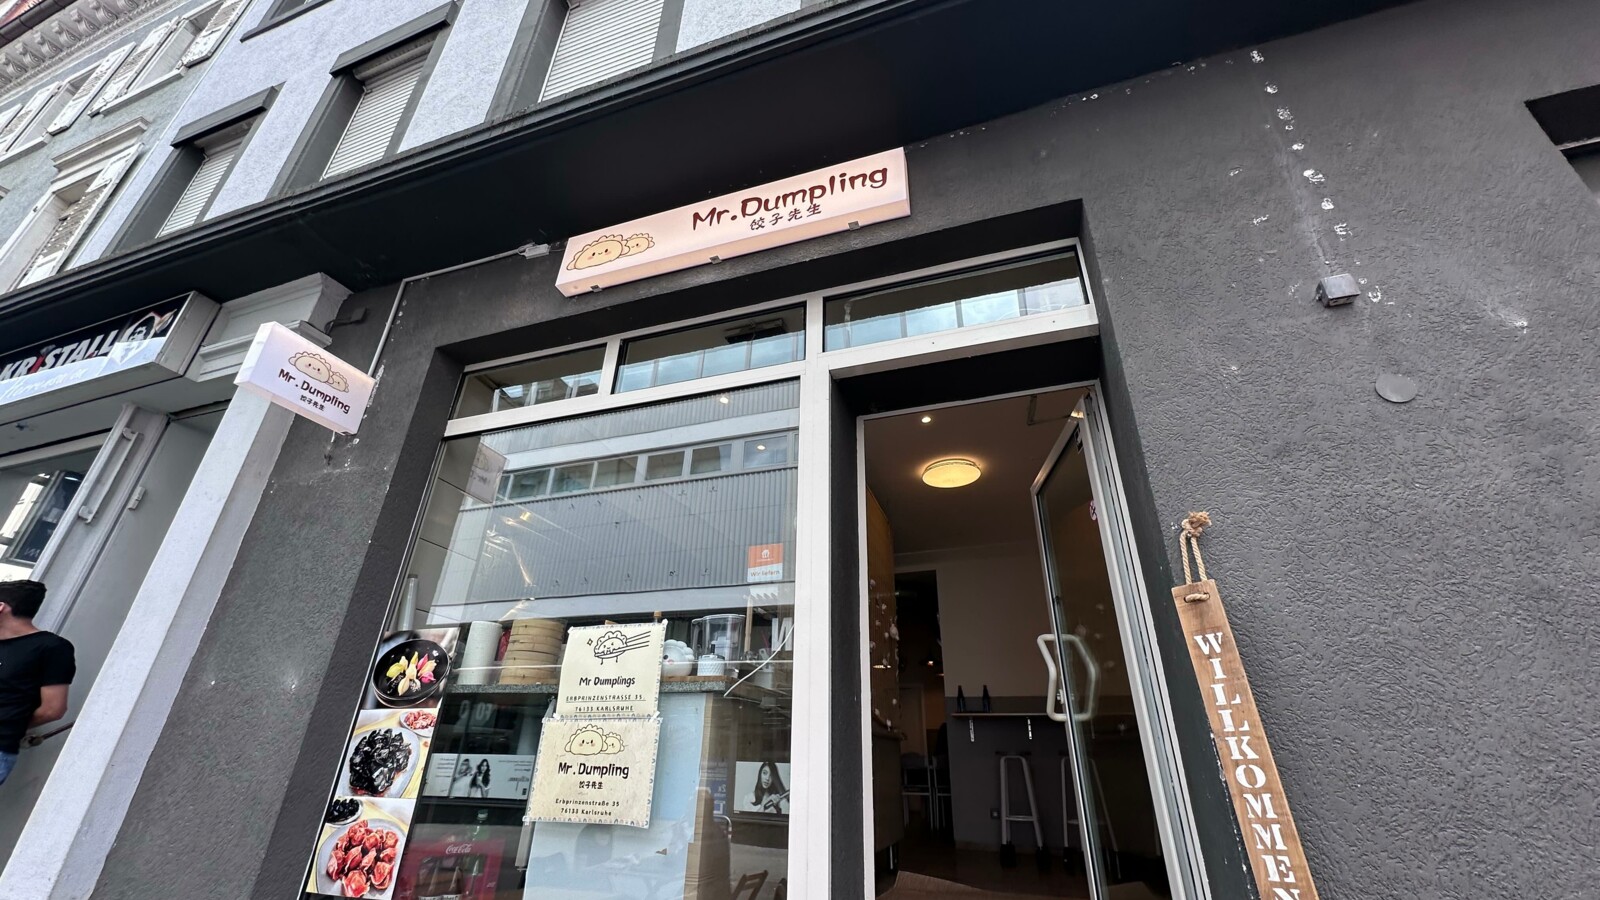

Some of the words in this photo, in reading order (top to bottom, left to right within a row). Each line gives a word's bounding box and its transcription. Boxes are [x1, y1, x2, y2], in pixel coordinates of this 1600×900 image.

[750, 204, 822, 231] 饺子先生
[278, 368, 299, 388] Mr.
[300, 380, 351, 414] Dumpling
[579, 677, 591, 686] Mr
[594, 676, 635, 687] Dumplings
[558, 762, 576, 775] Mr.
[578, 763, 630, 779] Dumpling
[555, 798, 610, 807] Erbprinzenstraße
